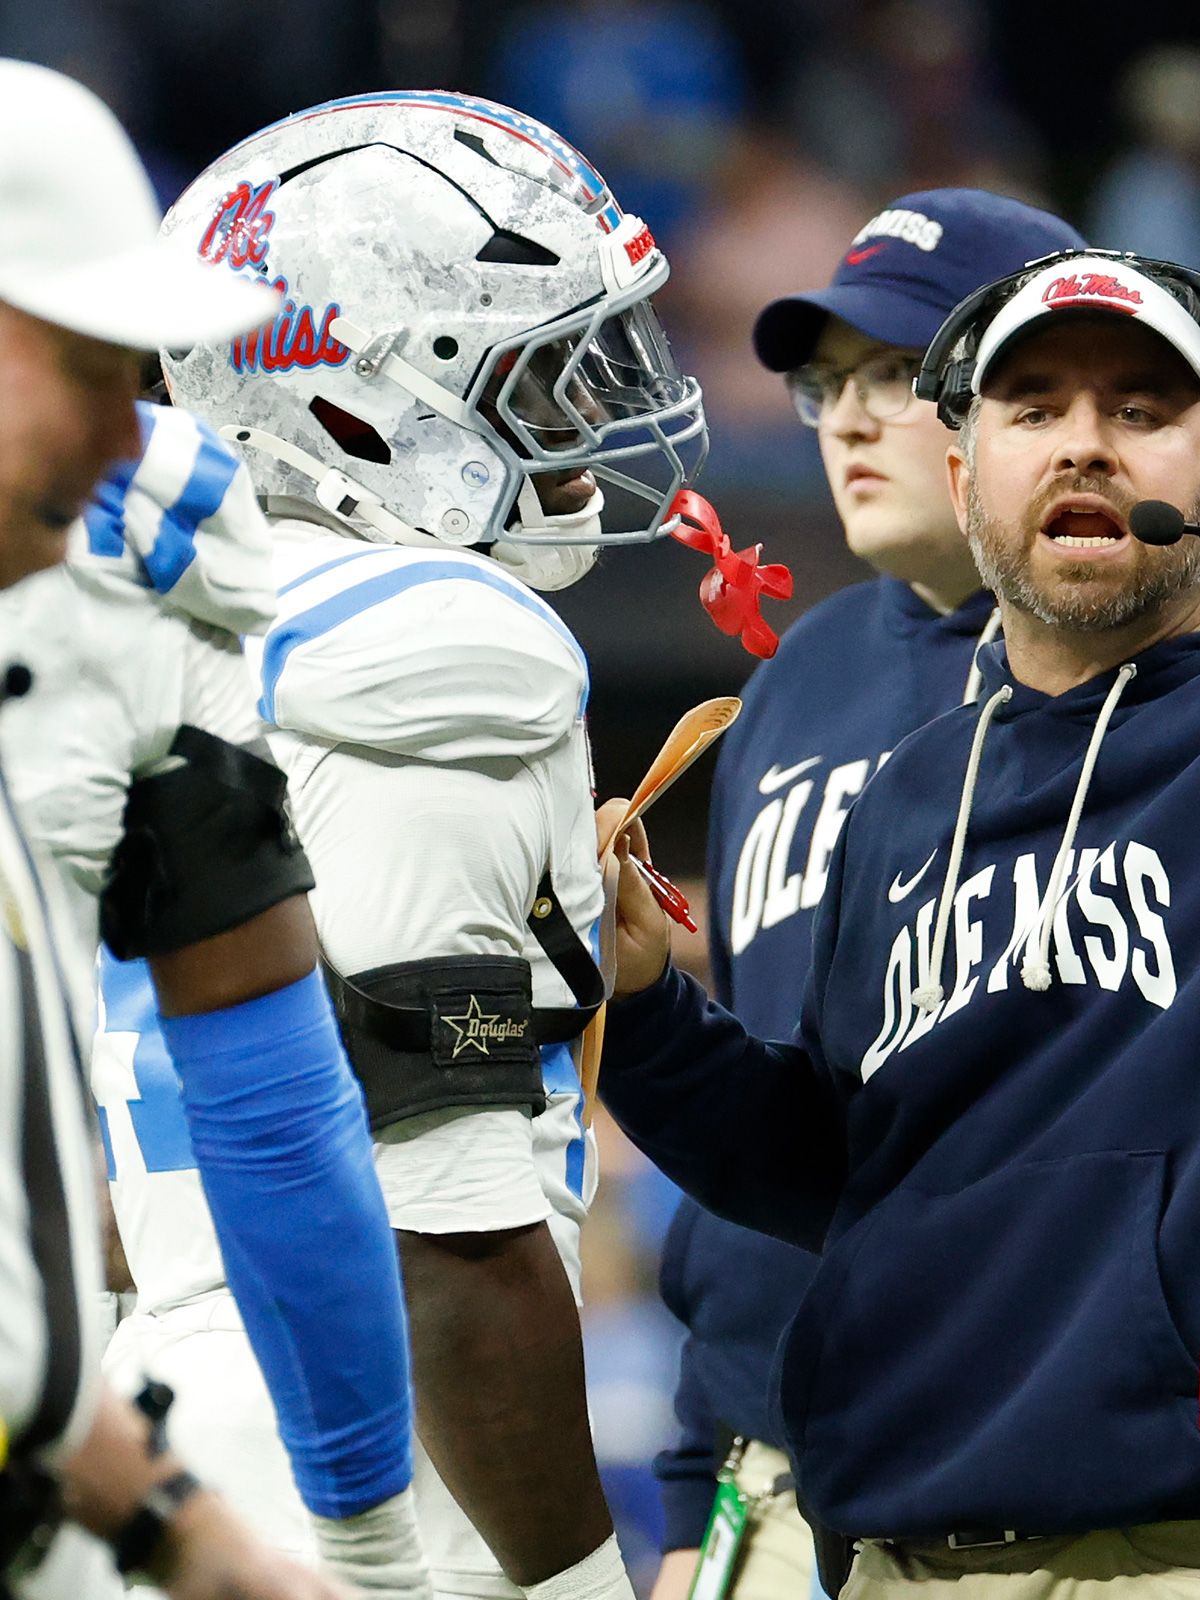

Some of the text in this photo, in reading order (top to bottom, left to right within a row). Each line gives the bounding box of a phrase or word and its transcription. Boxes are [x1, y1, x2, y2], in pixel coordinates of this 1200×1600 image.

[198, 176, 280, 271] Ole
[1041, 273, 1144, 304] Ole Miss
[861, 864, 996, 1085] OLE
[466, 1018, 525, 1042] Douglas
